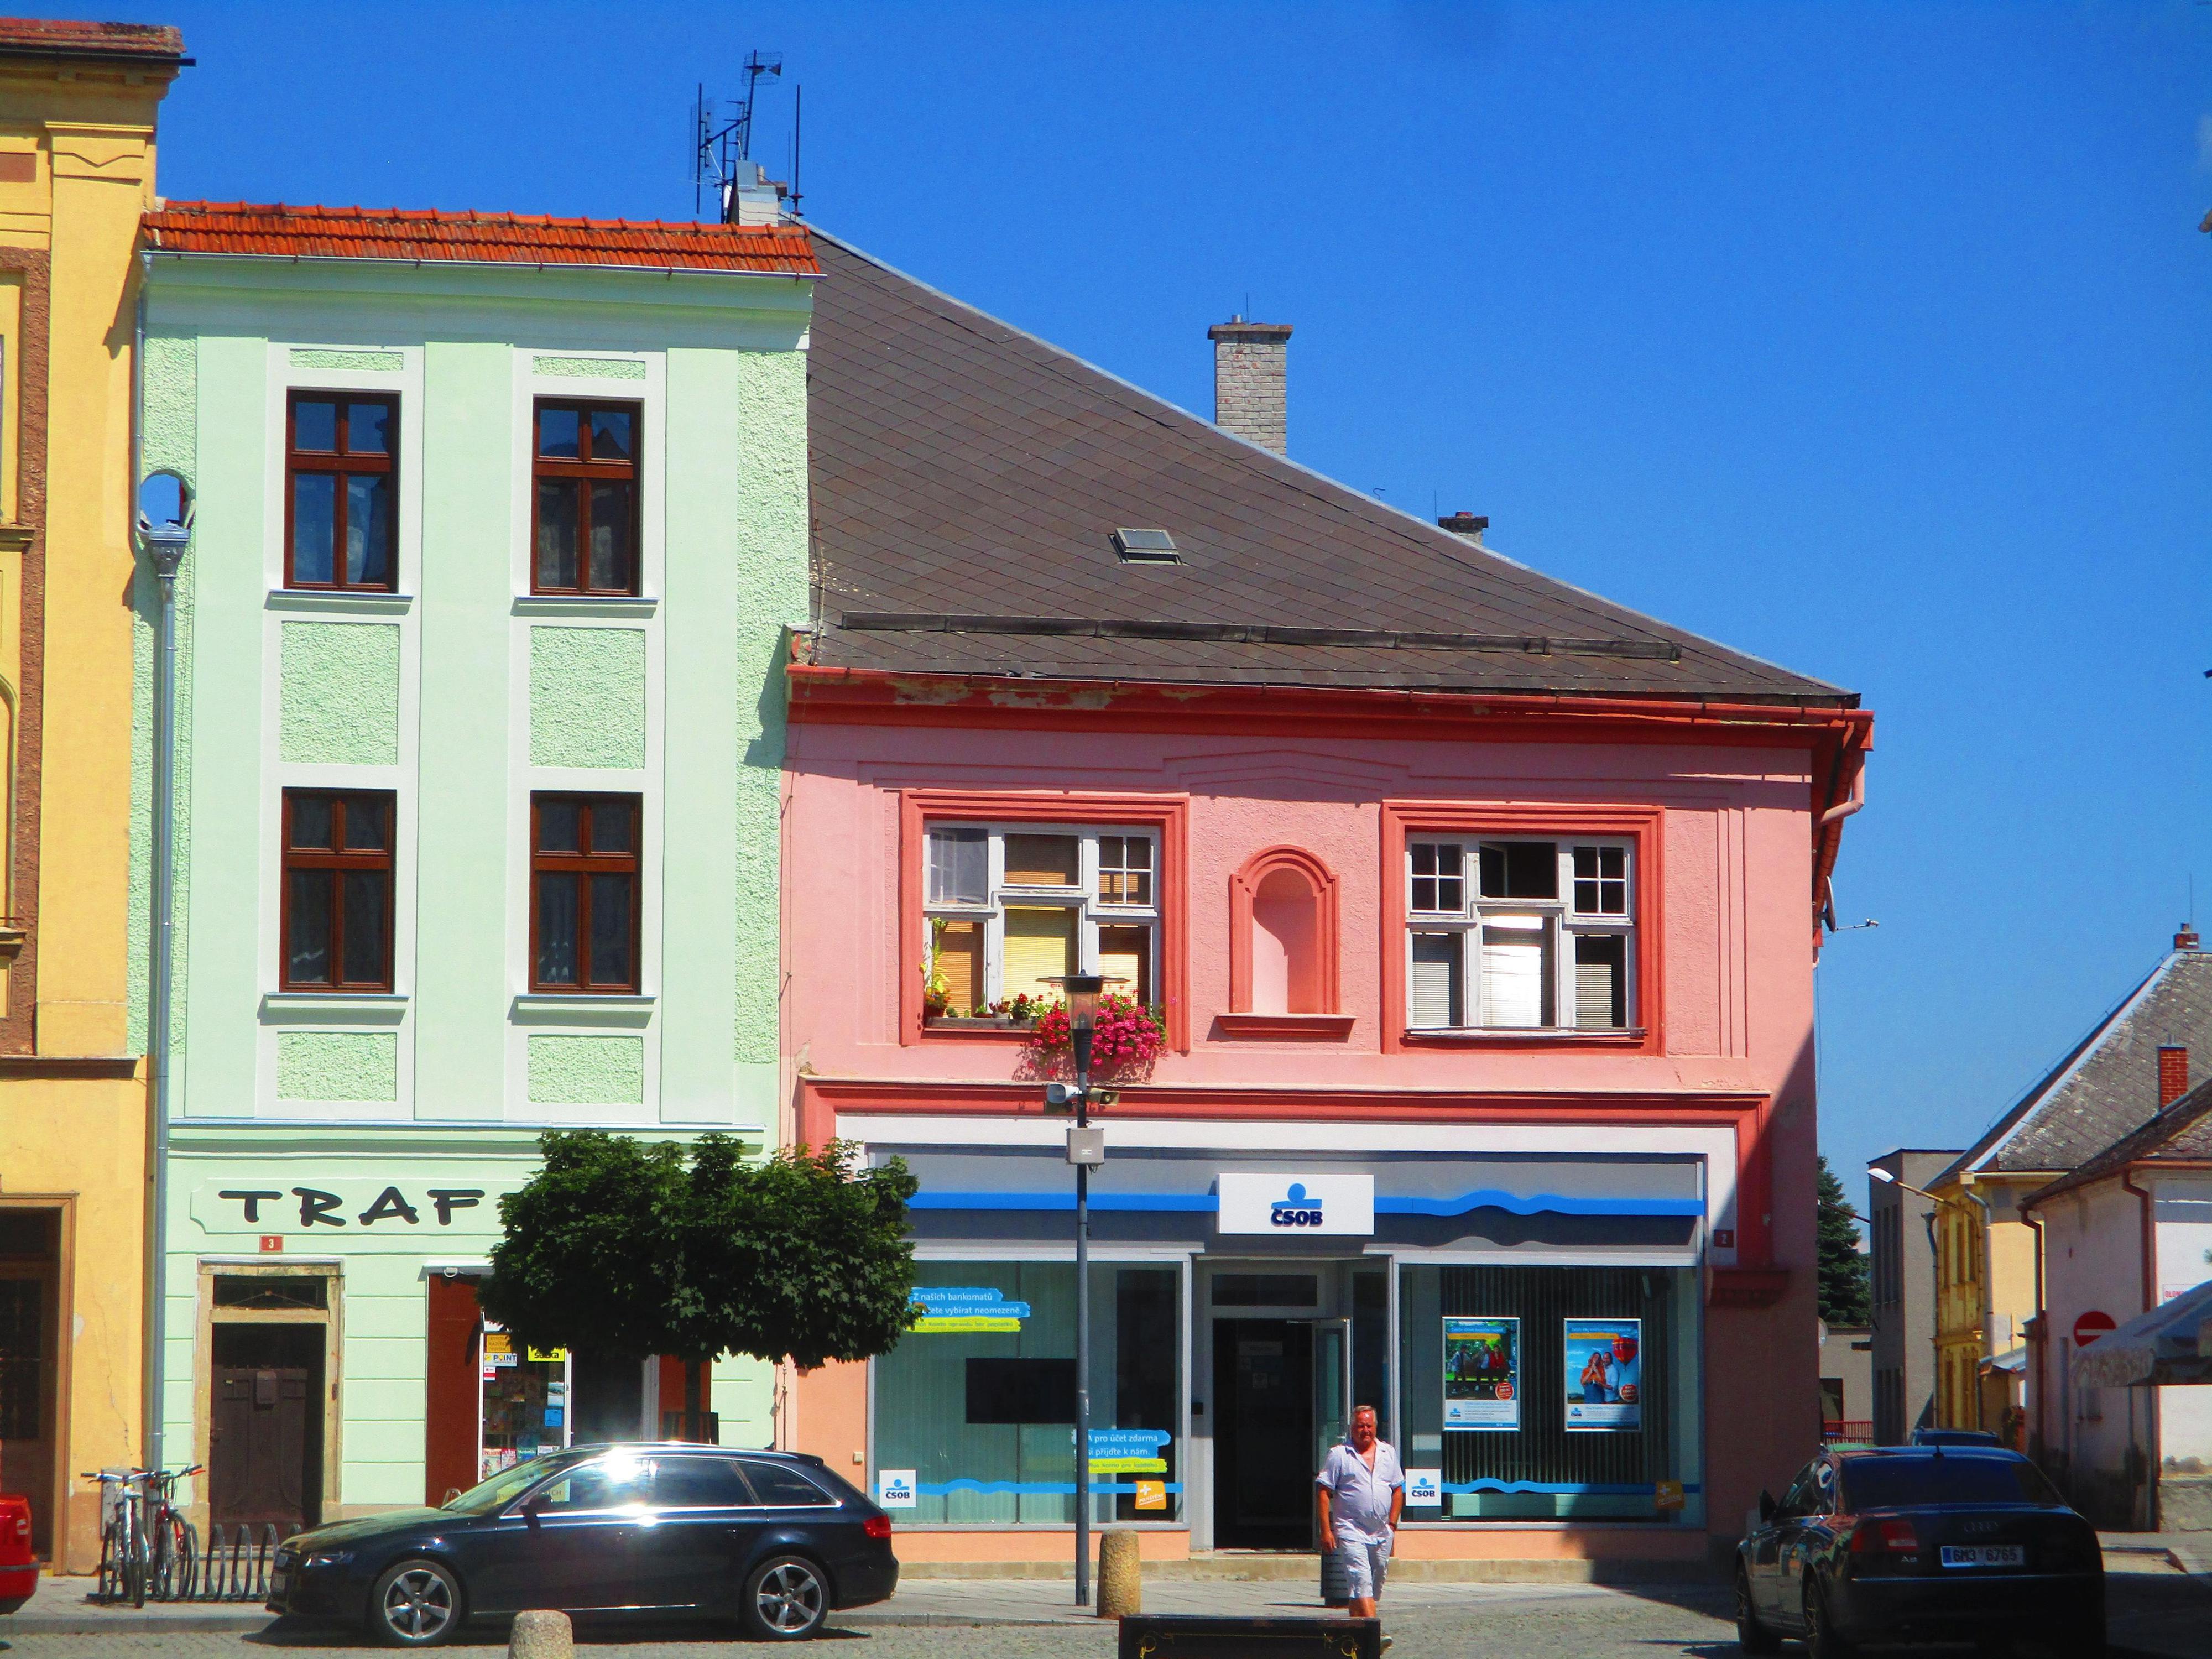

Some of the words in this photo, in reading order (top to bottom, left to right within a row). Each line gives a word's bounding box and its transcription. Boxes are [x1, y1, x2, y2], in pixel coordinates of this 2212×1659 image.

[218, 1186, 523, 1228] TRAF
[1271, 1208, 1323, 1226] ČSOB
[269, 1238, 274, 1249] 3
[1721, 1234, 1728, 1244] 2
[945, 1306, 973, 1316] vybírat
[1095, 1447, 1121, 1458] přijďte
[1123, 1447, 1128, 1455] k
[886, 1491, 910, 1499] ČSOB
